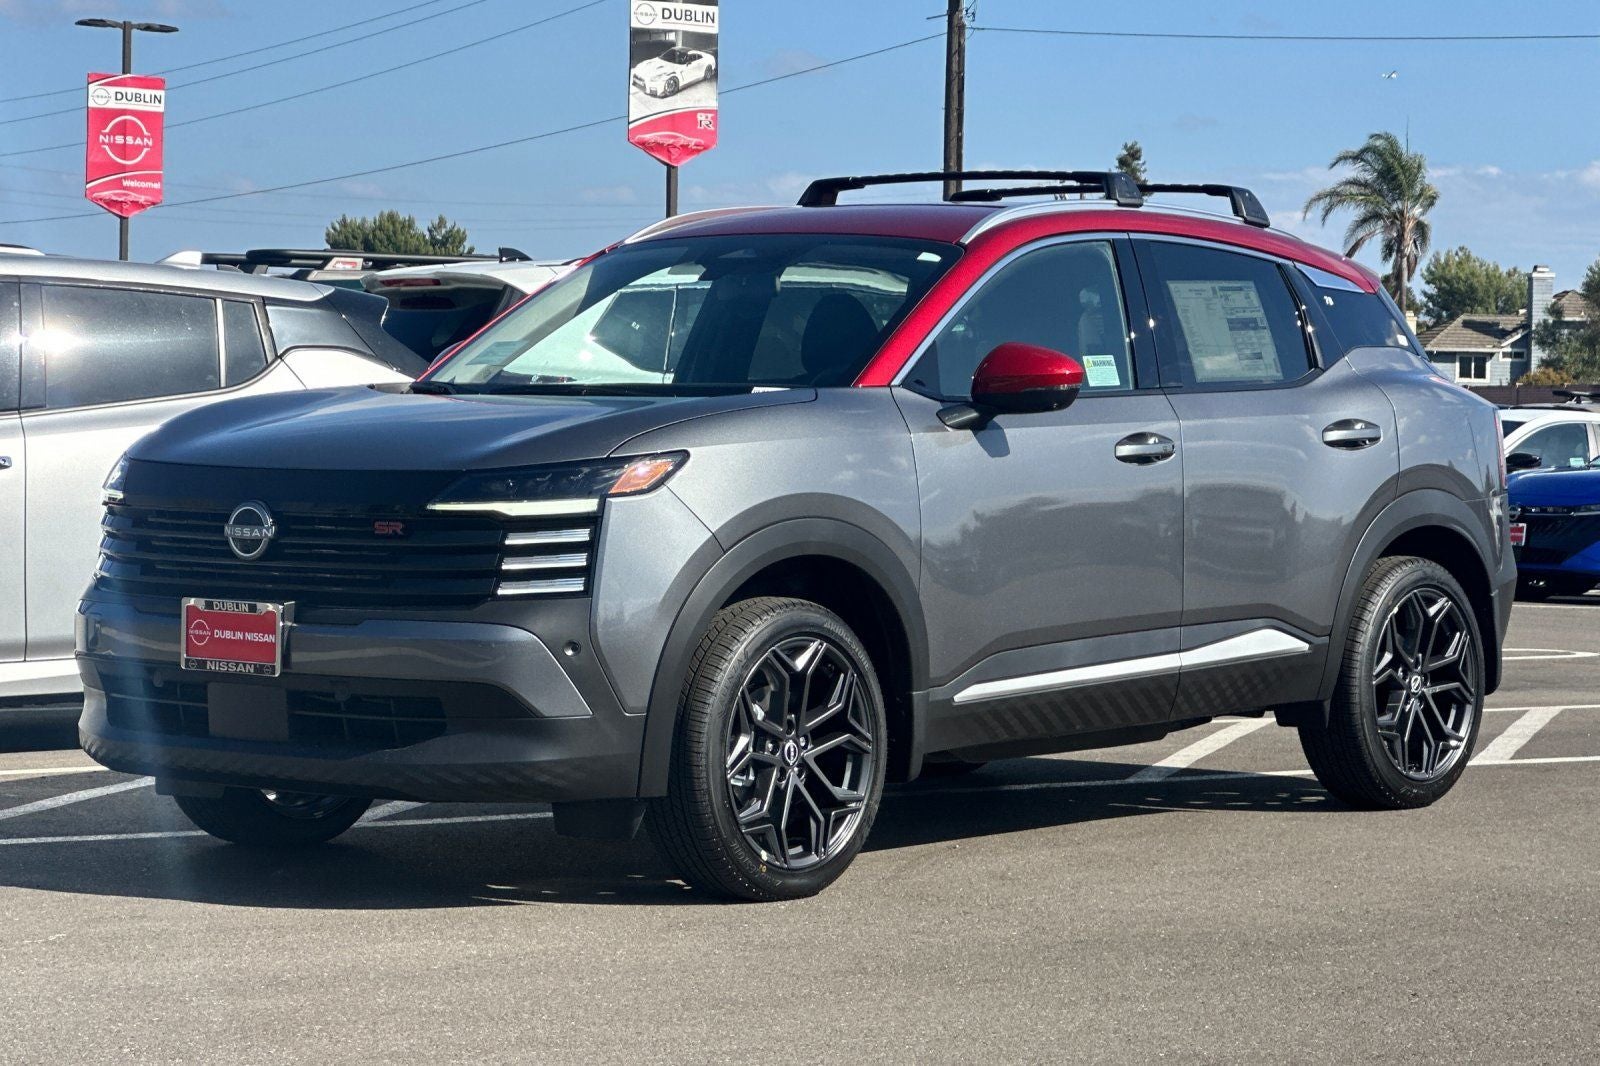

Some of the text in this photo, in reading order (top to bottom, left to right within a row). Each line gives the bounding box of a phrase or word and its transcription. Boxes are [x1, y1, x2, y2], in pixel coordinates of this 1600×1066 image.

[661, 7, 715, 24] DUBLIN
[114, 90, 162, 105] DUBLIN
[99, 134, 152, 147] NISSAN
[122, 179, 161, 189] Welcome!
[224, 524, 273, 539] NISSAN
[374, 521, 403, 535] SR
[213, 601, 249, 613] DUBLIN
[213, 629, 276, 643] DUBLIN NISSAN
[206, 660, 255, 674] NISSAN
